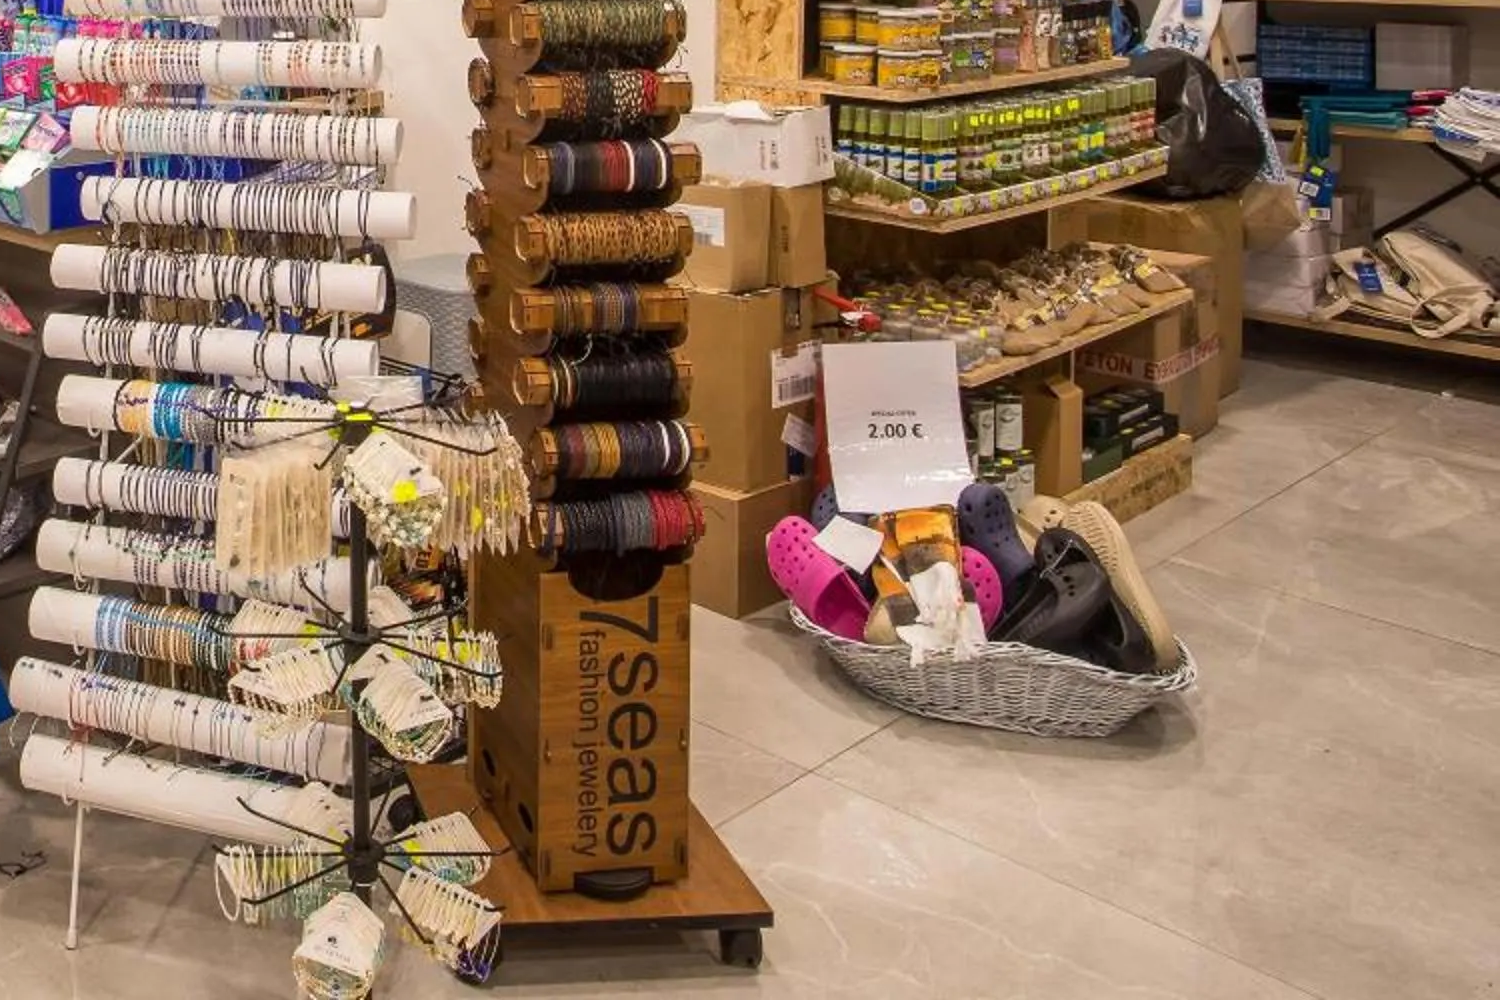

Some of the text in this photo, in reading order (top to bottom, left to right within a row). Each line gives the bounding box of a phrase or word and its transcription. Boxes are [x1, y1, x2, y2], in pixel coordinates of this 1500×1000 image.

[867, 423, 923, 439] 2.00 €
[571, 628, 607, 858] fashion jewelery
[579, 596, 660, 856] 7seas
